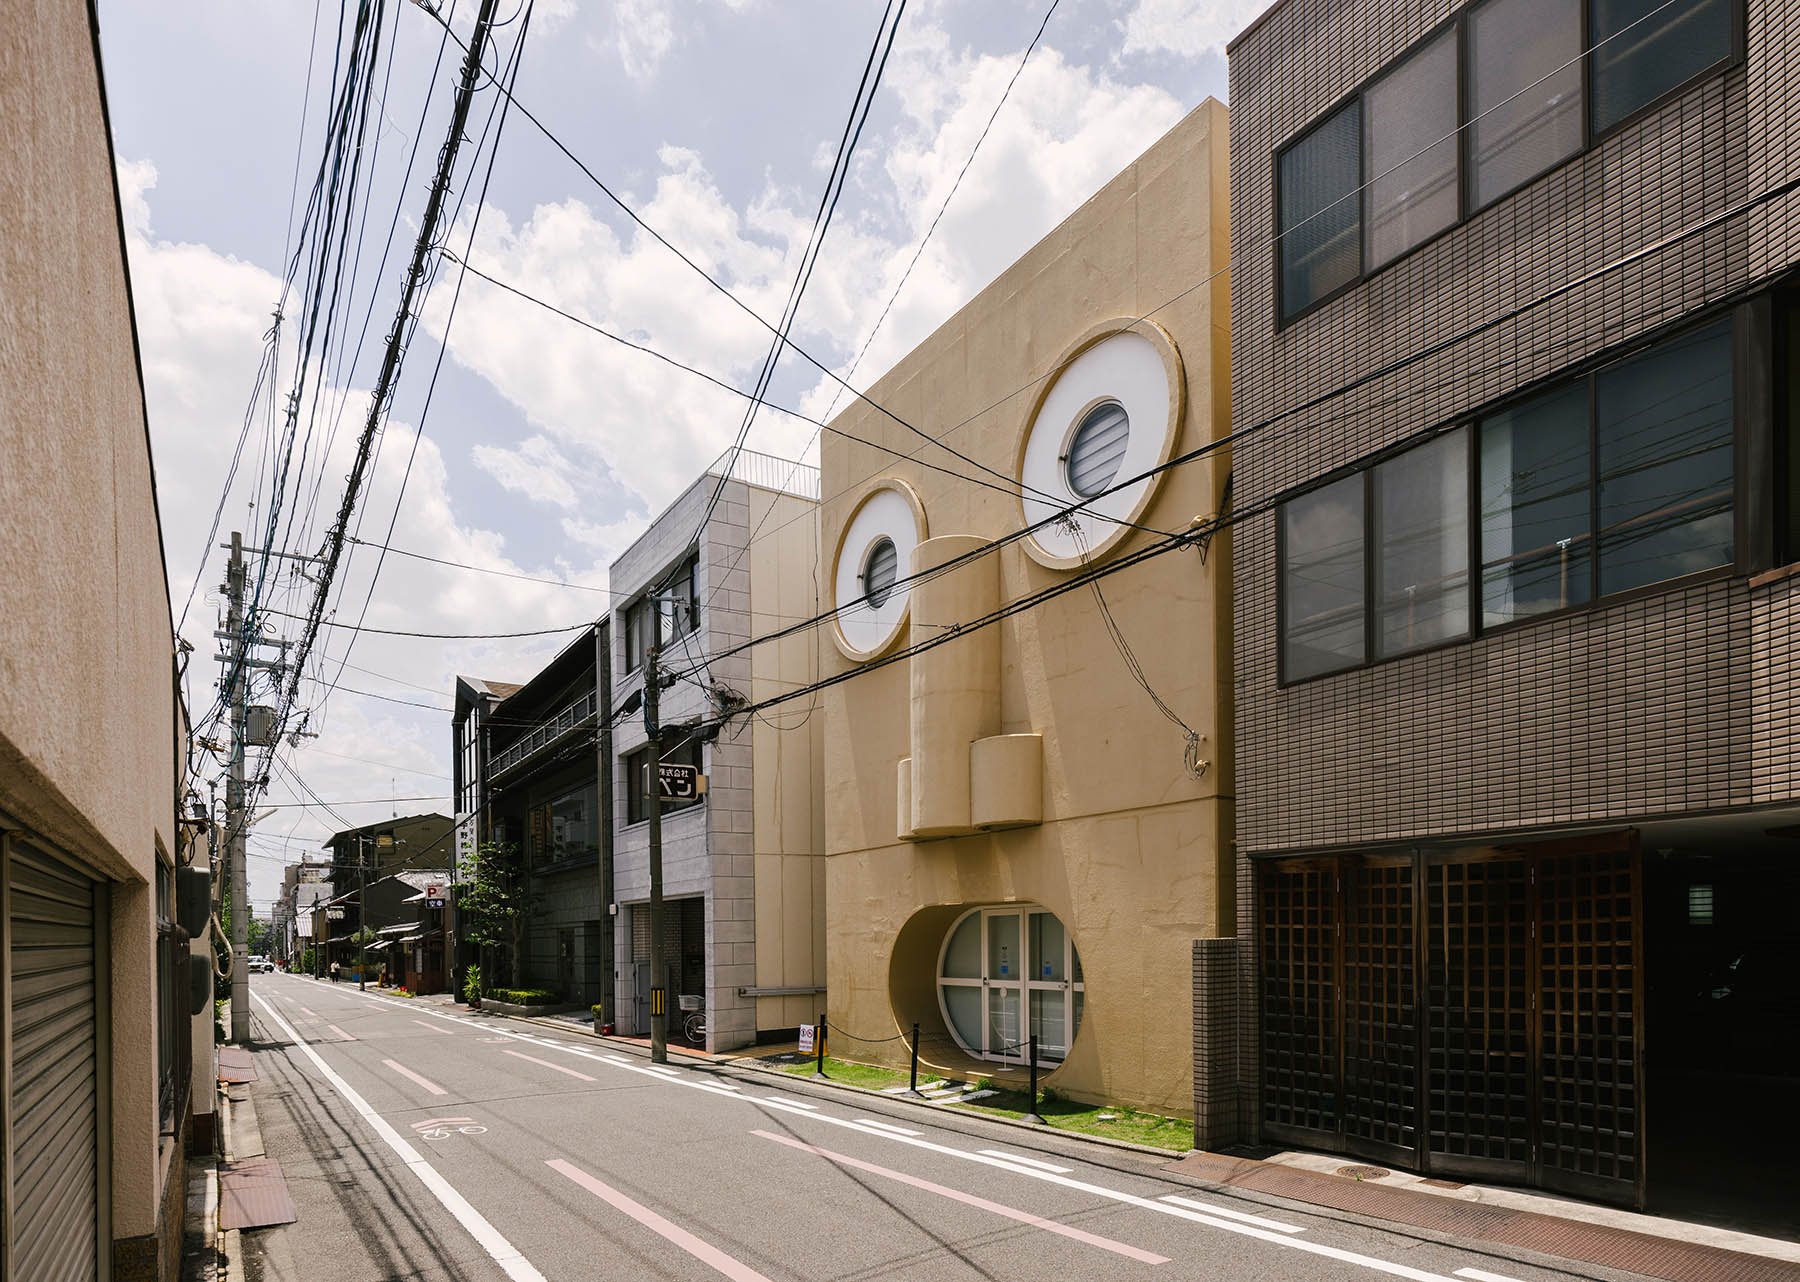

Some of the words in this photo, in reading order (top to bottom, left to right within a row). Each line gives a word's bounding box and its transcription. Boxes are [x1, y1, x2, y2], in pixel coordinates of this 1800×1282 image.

[659, 768, 689, 777] 株式会社
[428, 888, 437, 897] P
